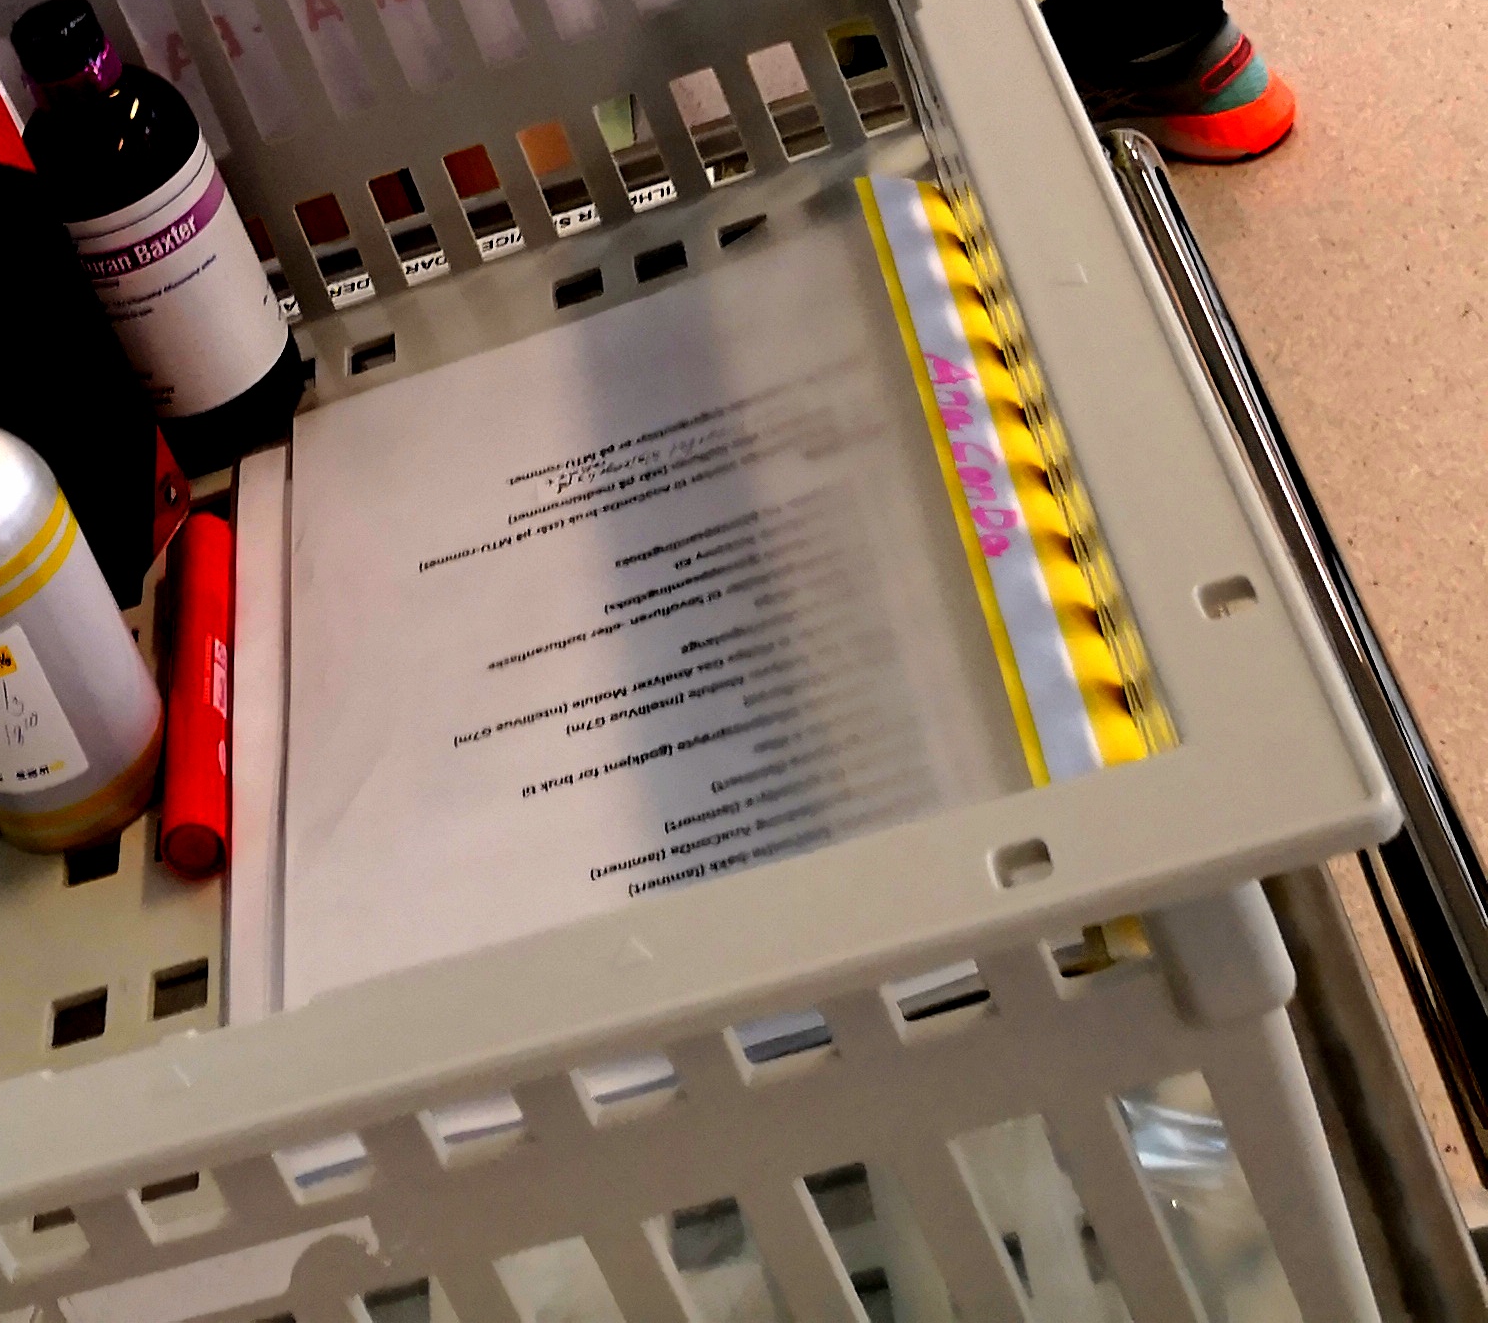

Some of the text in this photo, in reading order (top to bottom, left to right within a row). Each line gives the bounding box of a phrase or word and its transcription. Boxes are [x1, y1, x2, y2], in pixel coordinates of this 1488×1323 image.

[133, 213, 198, 266] Baxter
[571, 685, 627, 711] Module
[538, 773, 575, 793] bruk
[576, 766, 600, 782] for
[519, 783, 537, 798] til
[587, 847, 667, 882] (laminert)
[626, 862, 706, 898] (laminert)
